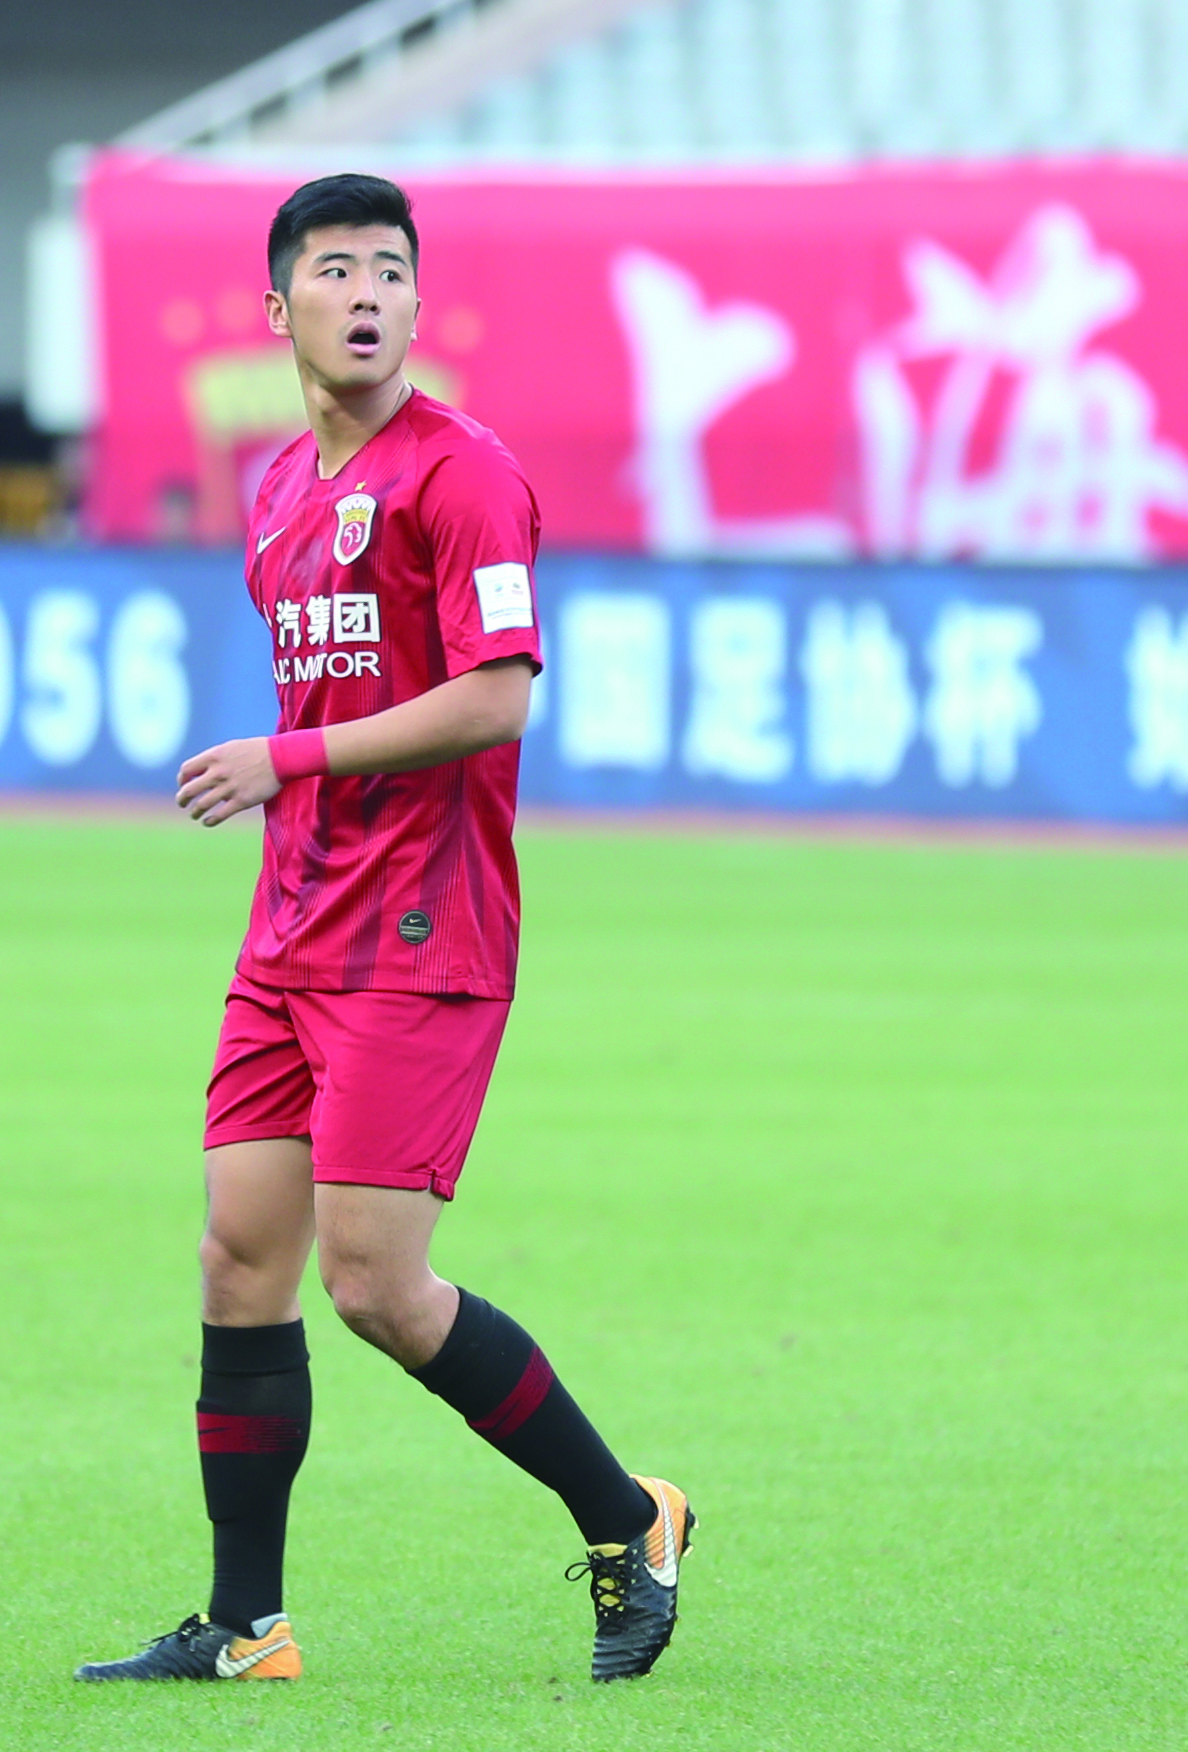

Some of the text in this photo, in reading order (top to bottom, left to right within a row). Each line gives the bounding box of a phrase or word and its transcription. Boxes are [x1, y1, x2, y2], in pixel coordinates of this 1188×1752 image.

[263, 593, 381, 649] 汽集团
[530, 595, 1044, 787] 国足协杯
